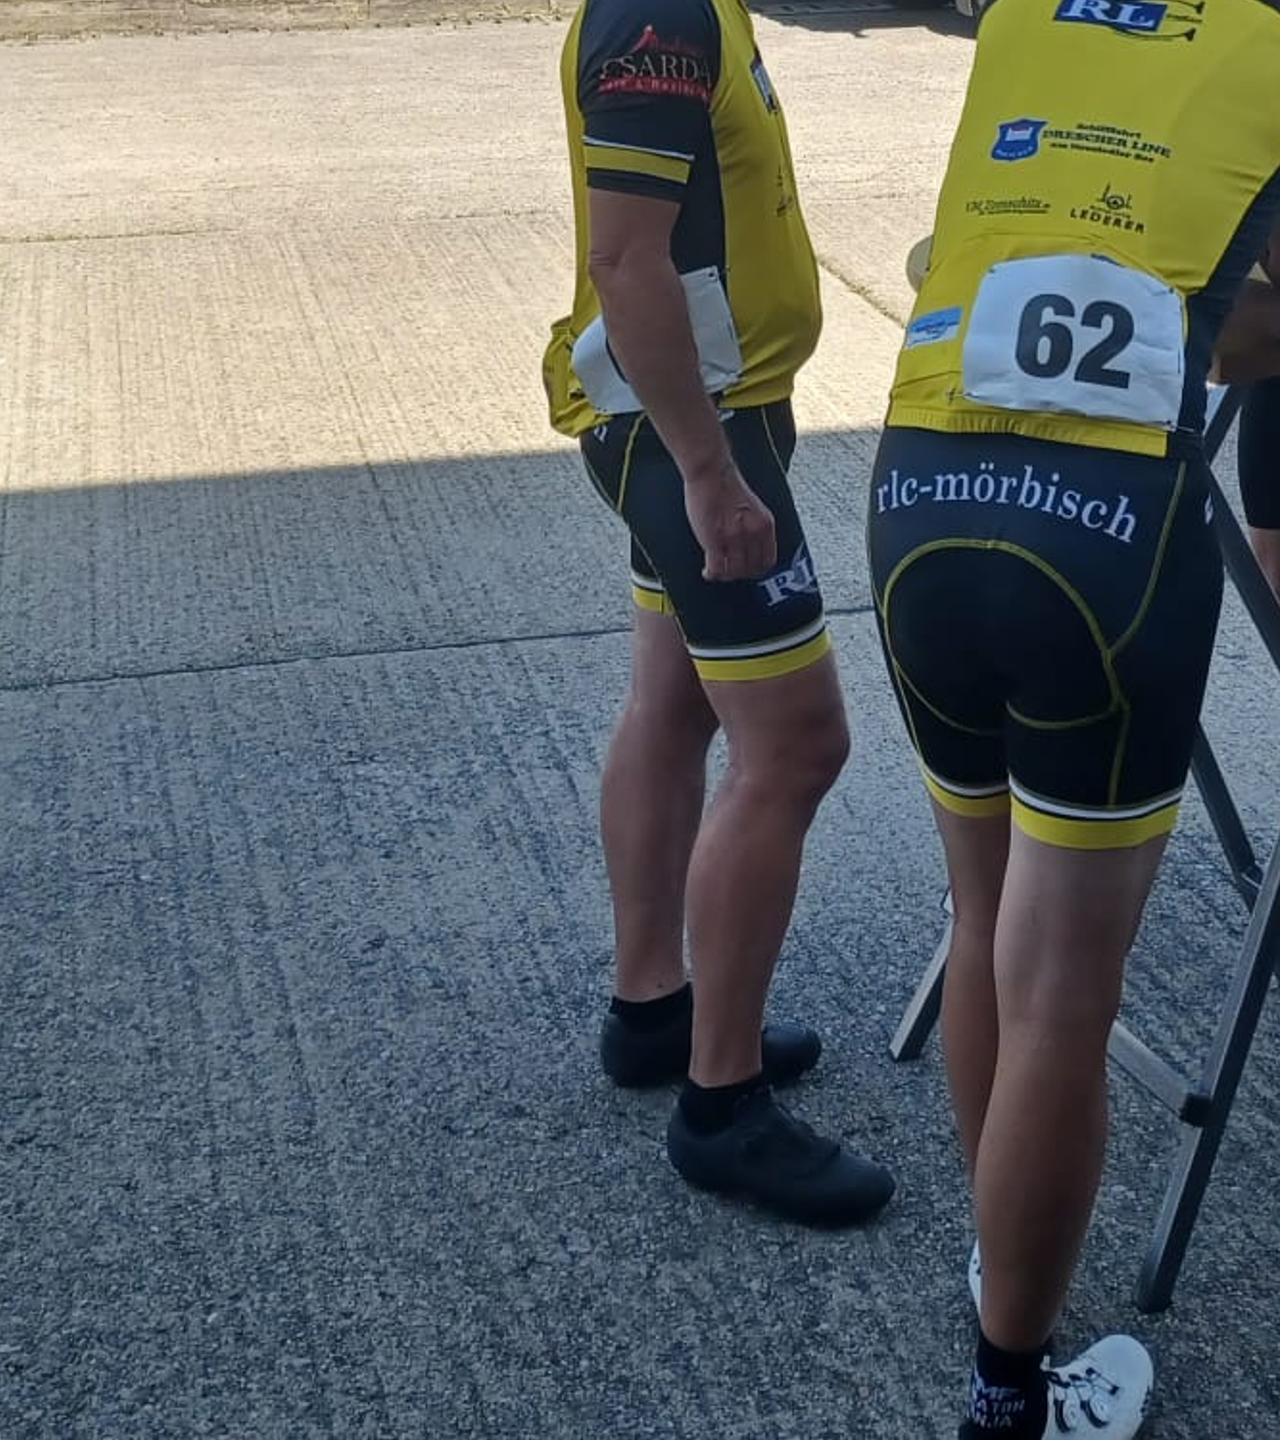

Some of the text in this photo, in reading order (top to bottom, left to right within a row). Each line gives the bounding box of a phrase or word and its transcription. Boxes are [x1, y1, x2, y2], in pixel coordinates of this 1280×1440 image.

[1132, 139, 1172, 158] LINE
[1070, 207, 1145, 234] LEDERER
[1015, 293, 1136, 389] 62
[875, 464, 1138, 544] rlc-mörbisch
